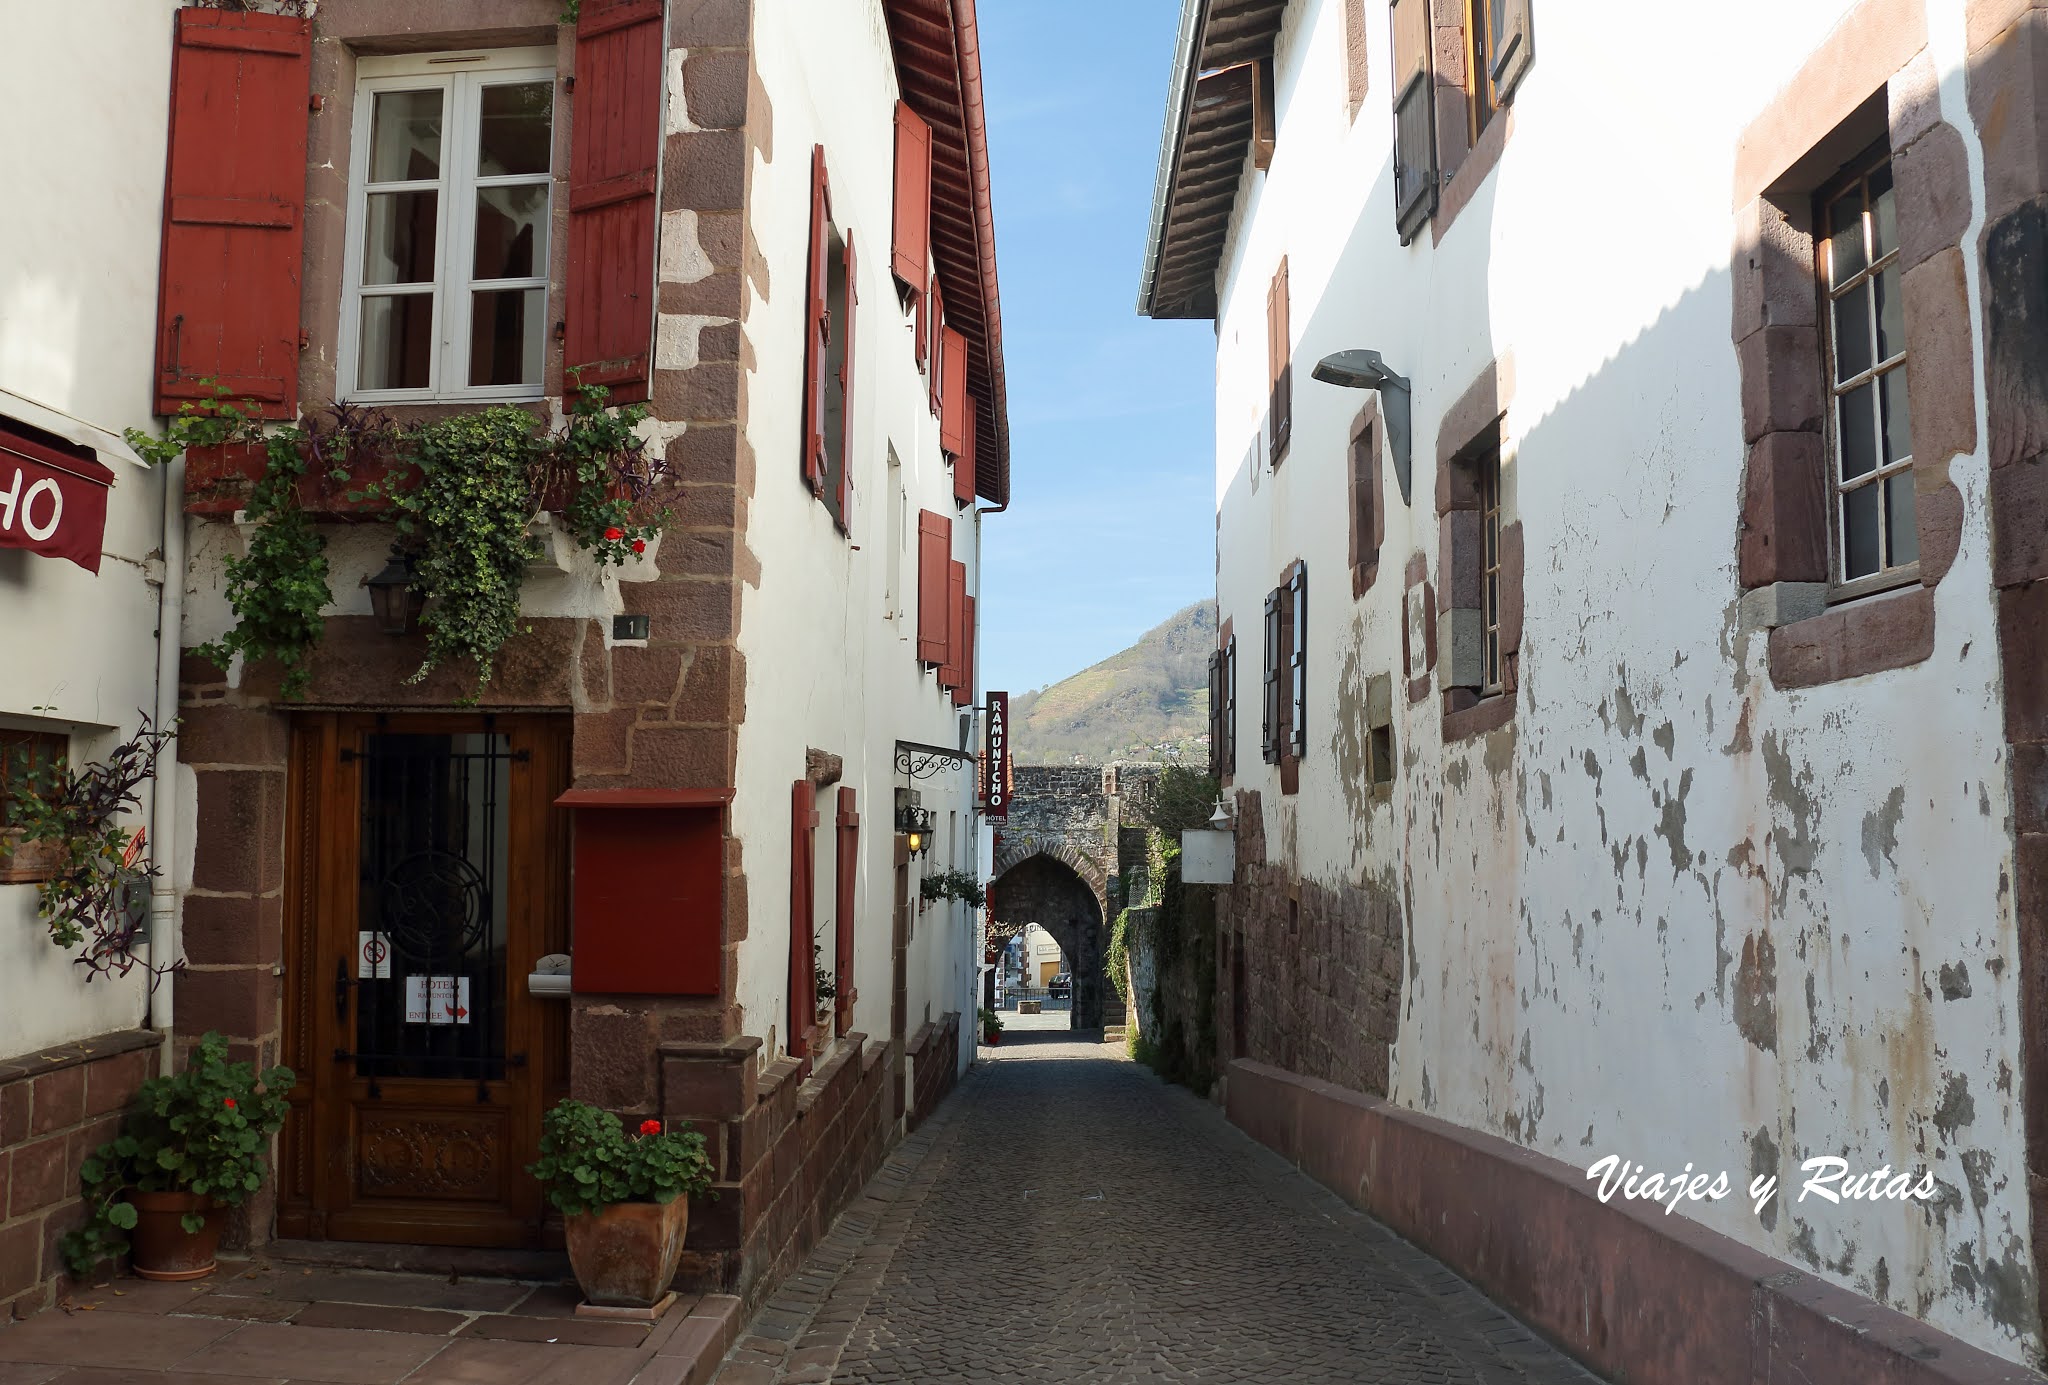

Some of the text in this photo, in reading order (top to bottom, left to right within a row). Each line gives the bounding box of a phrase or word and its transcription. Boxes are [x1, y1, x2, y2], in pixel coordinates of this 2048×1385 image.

[629, 620, 635, 635] 1
[990, 700, 1003, 806] RAMUNTCHO
[985, 813, 1007, 822] HÔTEL
[408, 1011, 443, 1020] ENTEE
